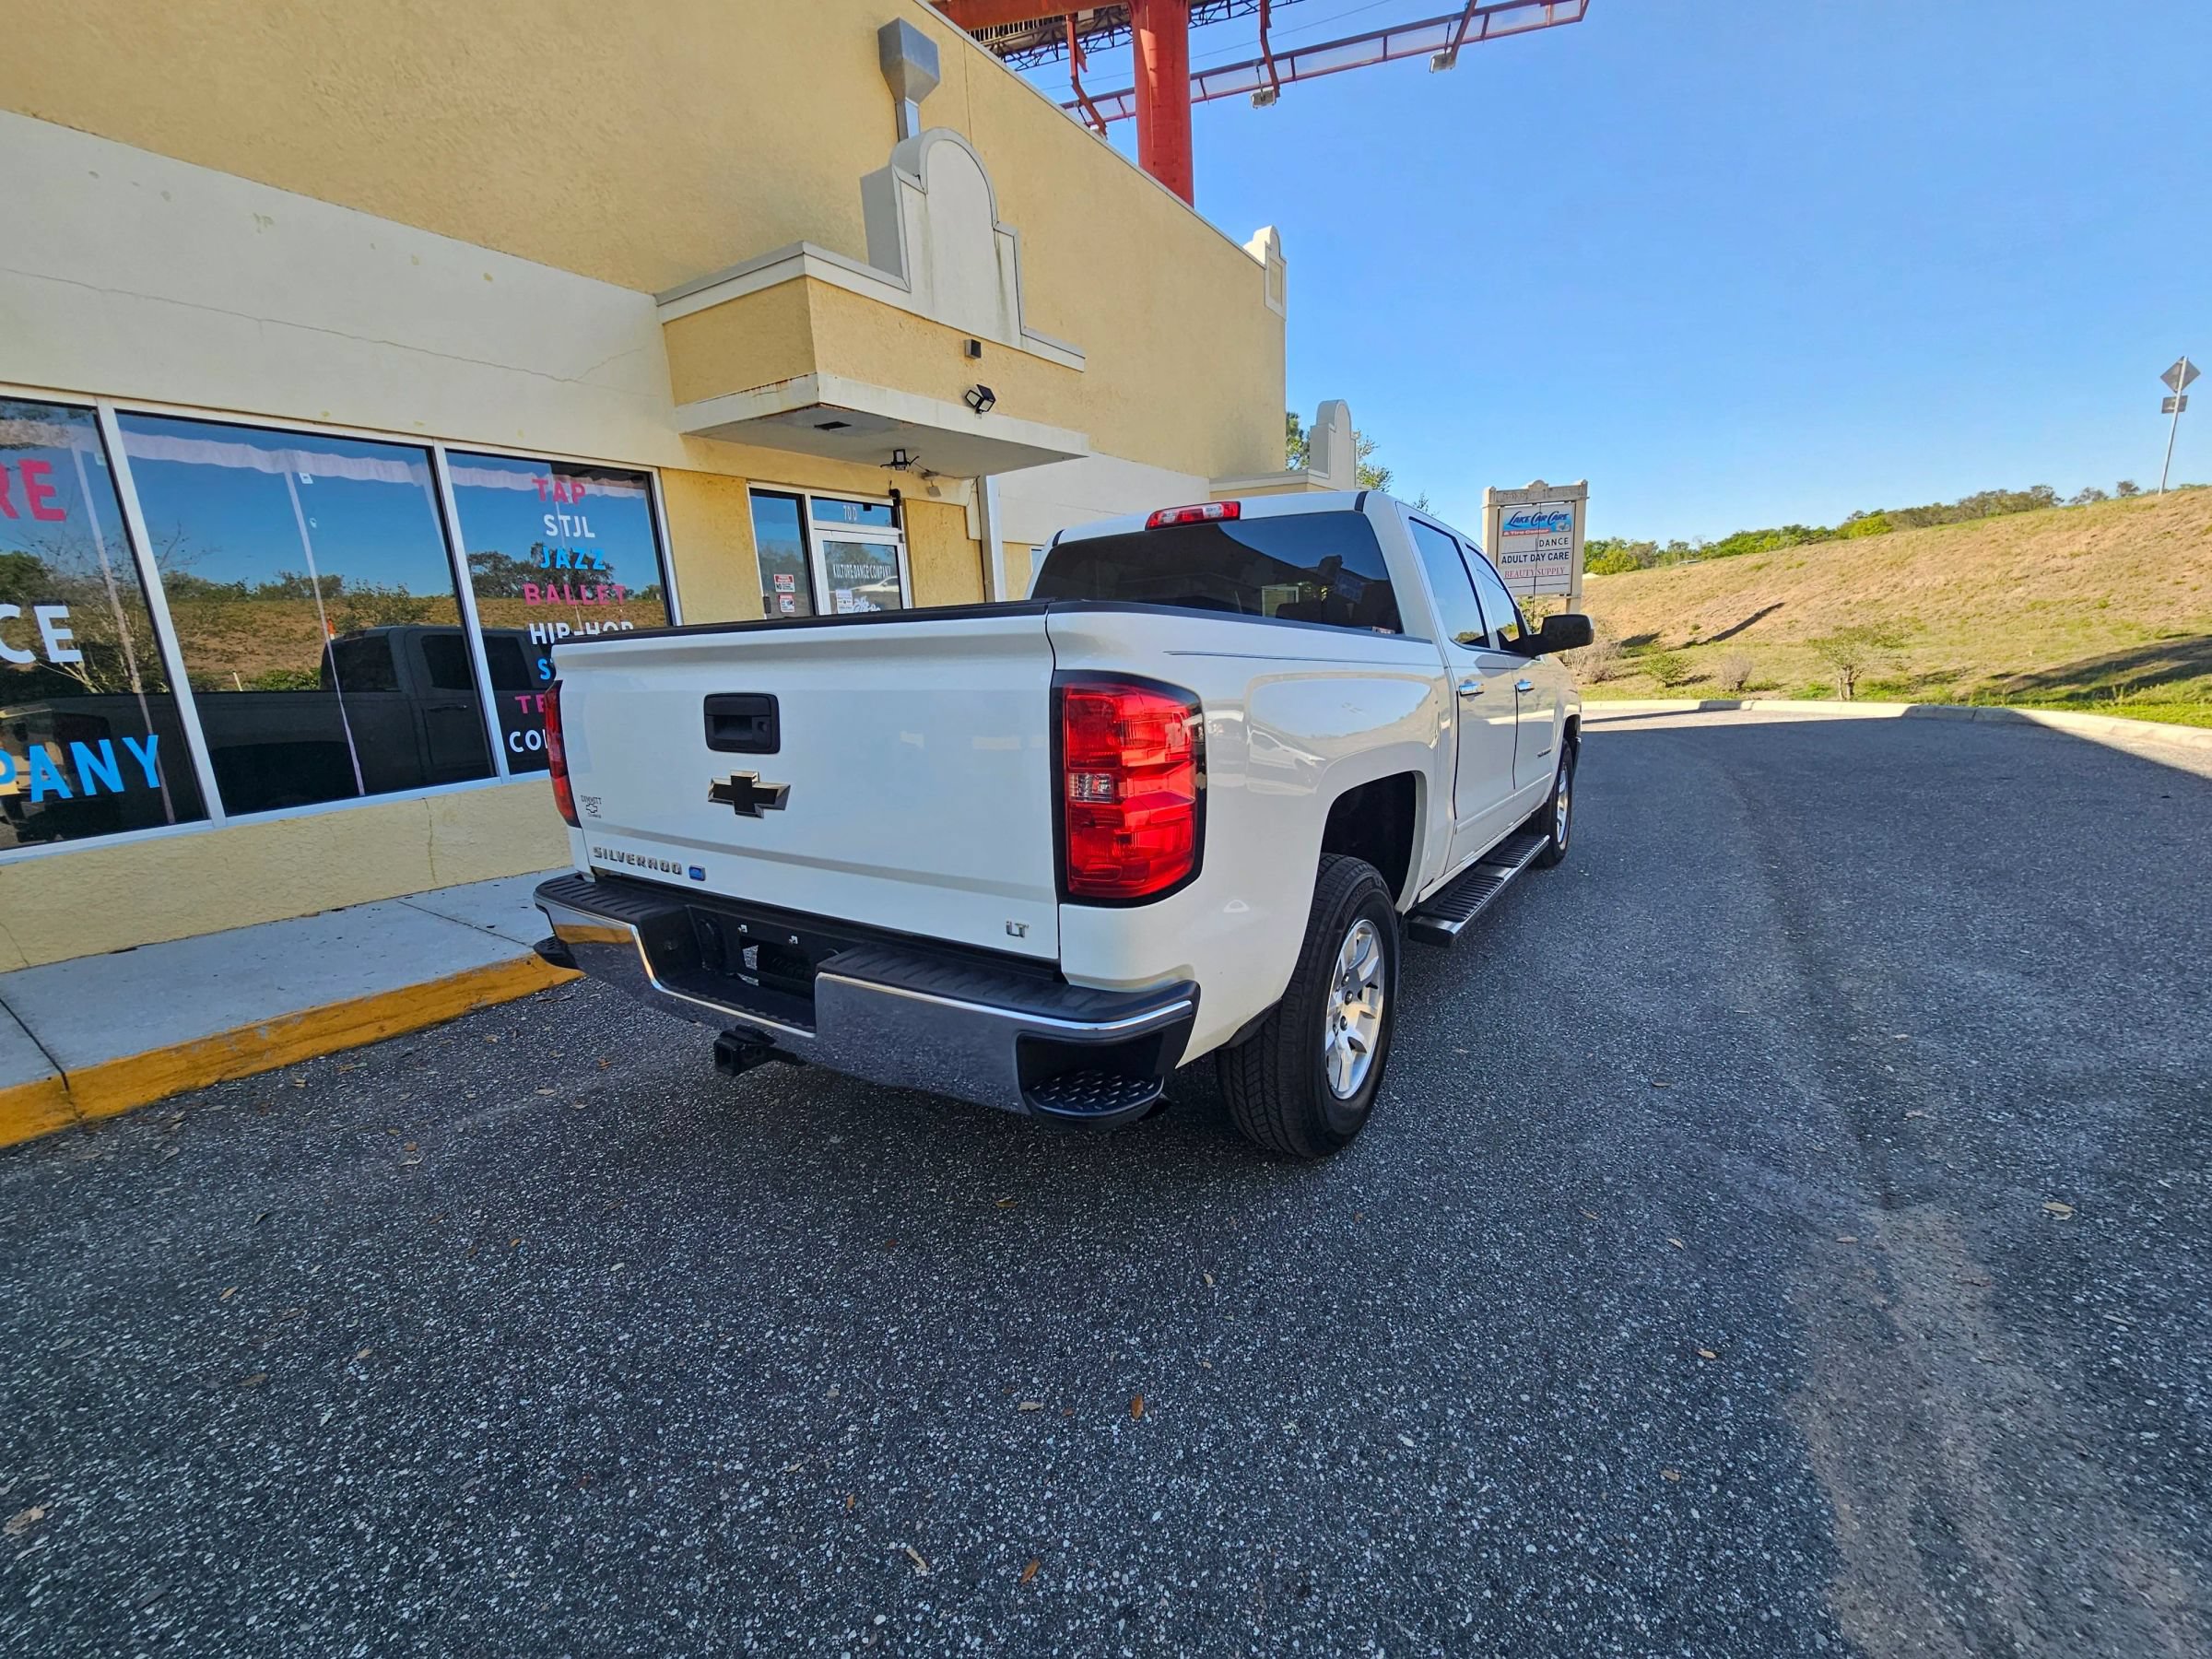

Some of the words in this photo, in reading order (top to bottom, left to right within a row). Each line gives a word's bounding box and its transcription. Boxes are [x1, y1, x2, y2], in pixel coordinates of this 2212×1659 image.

[532, 478, 587, 505] TAP
[544, 514, 595, 538] STJL
[1539, 537, 1569, 547] DANCE
[540, 546, 606, 571] JAZZ
[1501, 555, 1528, 564] ADULT
[1530, 553, 1546, 562] DAY
[1547, 551, 1570, 560] CARE
[1504, 569, 1535, 578] BEAUTY
[1536, 567, 1565, 576] SUPPLY
[523, 583, 626, 606] BALLET
[509, 730, 549, 753] CO
[593, 846, 682, 875] SILVERADO
[1006, 921, 1029, 938] LT
